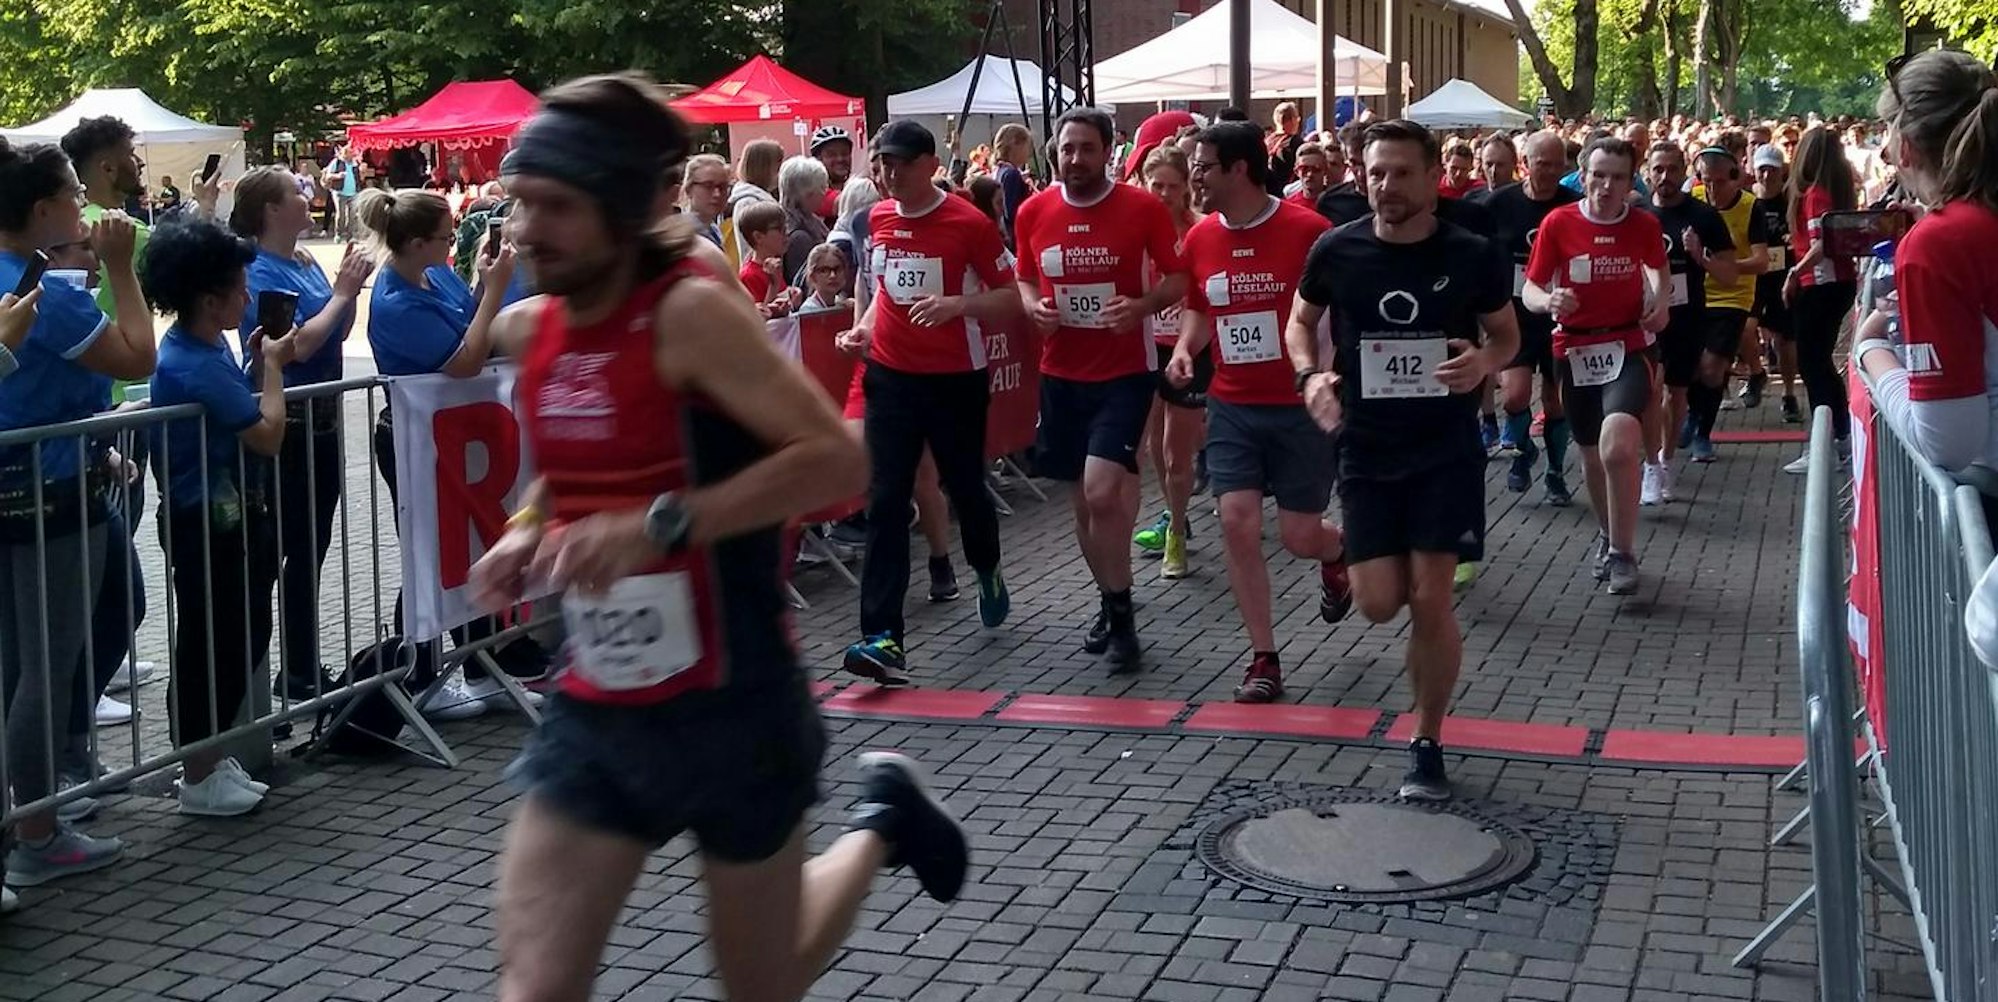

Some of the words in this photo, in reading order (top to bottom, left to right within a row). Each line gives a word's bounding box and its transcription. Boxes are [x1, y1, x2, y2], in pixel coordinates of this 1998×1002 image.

[1067, 224, 1091, 233] REWE
[1065, 246, 1109, 257] KÖLNER
[1232, 248, 1255, 258] REWE
[1065, 256, 1120, 267] LESELAUF
[897, 271, 926, 287] 837
[1231, 273, 1274, 284] KÖLNER
[1231, 282, 1287, 294] LESELAUF
[1070, 296, 1101, 312] 505
[1230, 326, 1262, 345] 504
[1385, 356, 1423, 375] 412
[1582, 354, 1614, 371] 1414
